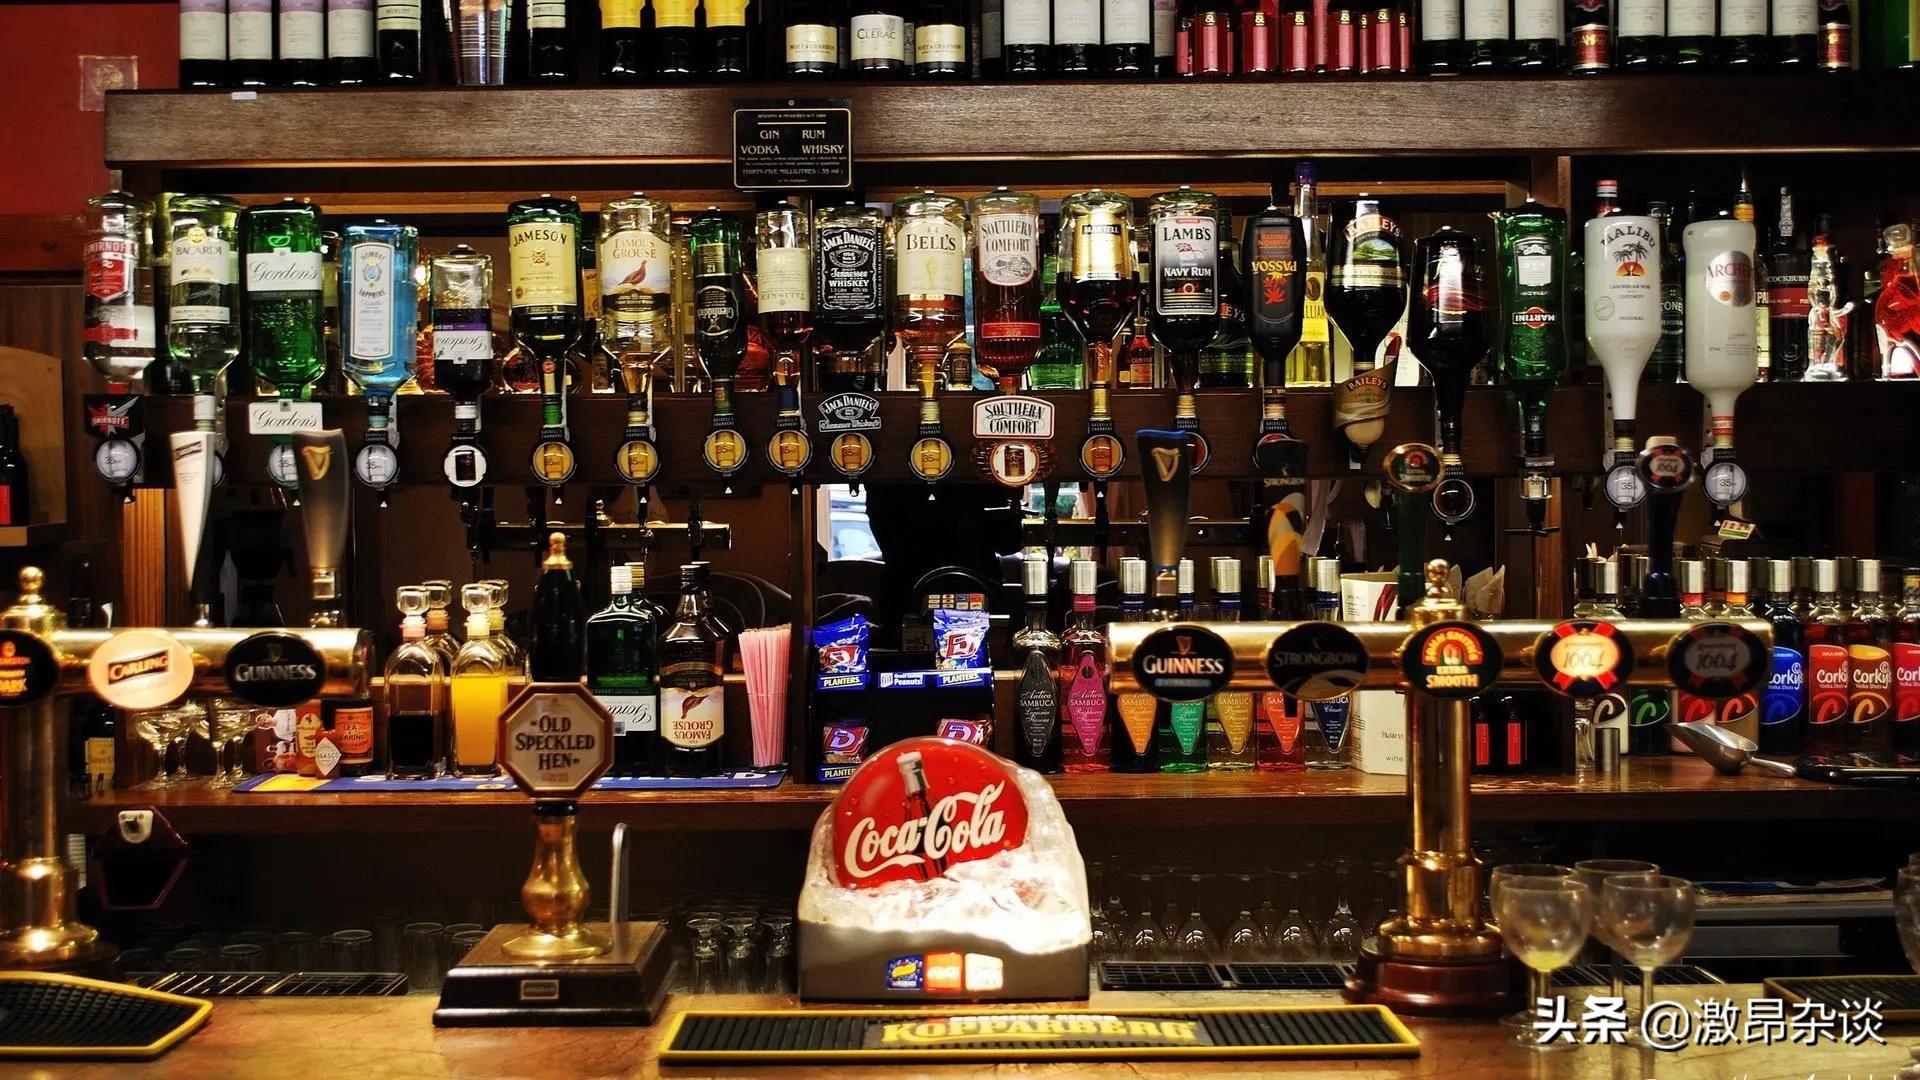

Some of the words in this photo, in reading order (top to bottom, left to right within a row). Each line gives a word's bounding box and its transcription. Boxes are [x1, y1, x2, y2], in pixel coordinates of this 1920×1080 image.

[760, 130, 780, 139] GIN
[802, 129, 825, 139] RUM
[741, 145, 780, 154] VODKA
[801, 144, 844, 154] WHISKY
[981, 219, 1034, 239] SOUTHERN
[1163, 226, 1212, 241] LAMB'S
[1600, 225, 1656, 249] MALIBU
[513, 229, 567, 248] JAMESON
[614, 238, 655, 249] FAMOUS
[823, 235, 844, 252] JACK
[843, 231, 877, 251] DANIEL'S
[906, 234, 956, 251] BELL'S
[985, 239, 1031, 253] COMFORT
[176, 245, 222, 256] BACARDI
[613, 248, 657, 259] GROUSE
[249, 261, 318, 282] Gordon's
[706, 264, 716, 273] 12
[1163, 266, 1190, 277] NAVY
[1190, 265, 1212, 277] RUM
[1515, 314, 1555, 322] MARTINI
[1348, 376, 1387, 391] BAILEYS
[825, 398, 844, 414] JACK
[842, 395, 874, 411] DANIEL'S
[984, 401, 1046, 420] SOUTHERN
[253, 406, 320, 429] Gordon's
[989, 419, 1038, 434] COMFORT
[1143, 655, 1225, 674] GUINNESS
[1273, 651, 1360, 667] STRONGBOW
[1564, 647, 1605, 669] 1664
[1694, 650, 1737, 671] 1664
[110, 654, 169, 681] CARLING
[234, 663, 317, 683] GUINNESS
[1436, 665, 1468, 675] EXTRA
[824, 676, 860, 687] PLANTERS
[943, 673, 978, 684] PLANTERS
[1426, 674, 1479, 689] SMOOTH
[1020, 699, 1054, 707] SAMBUCA
[539, 714, 571, 733] OLD
[672, 720, 714, 731] GROUSE
[515, 732, 595, 751] SPECKLED
[673, 730, 711, 740] FAMOUS
[538, 752, 573, 770] HEN
[844, 780, 1006, 878] Coca-Cola
[880, 1019, 1197, 1043] KOPPARBERG
